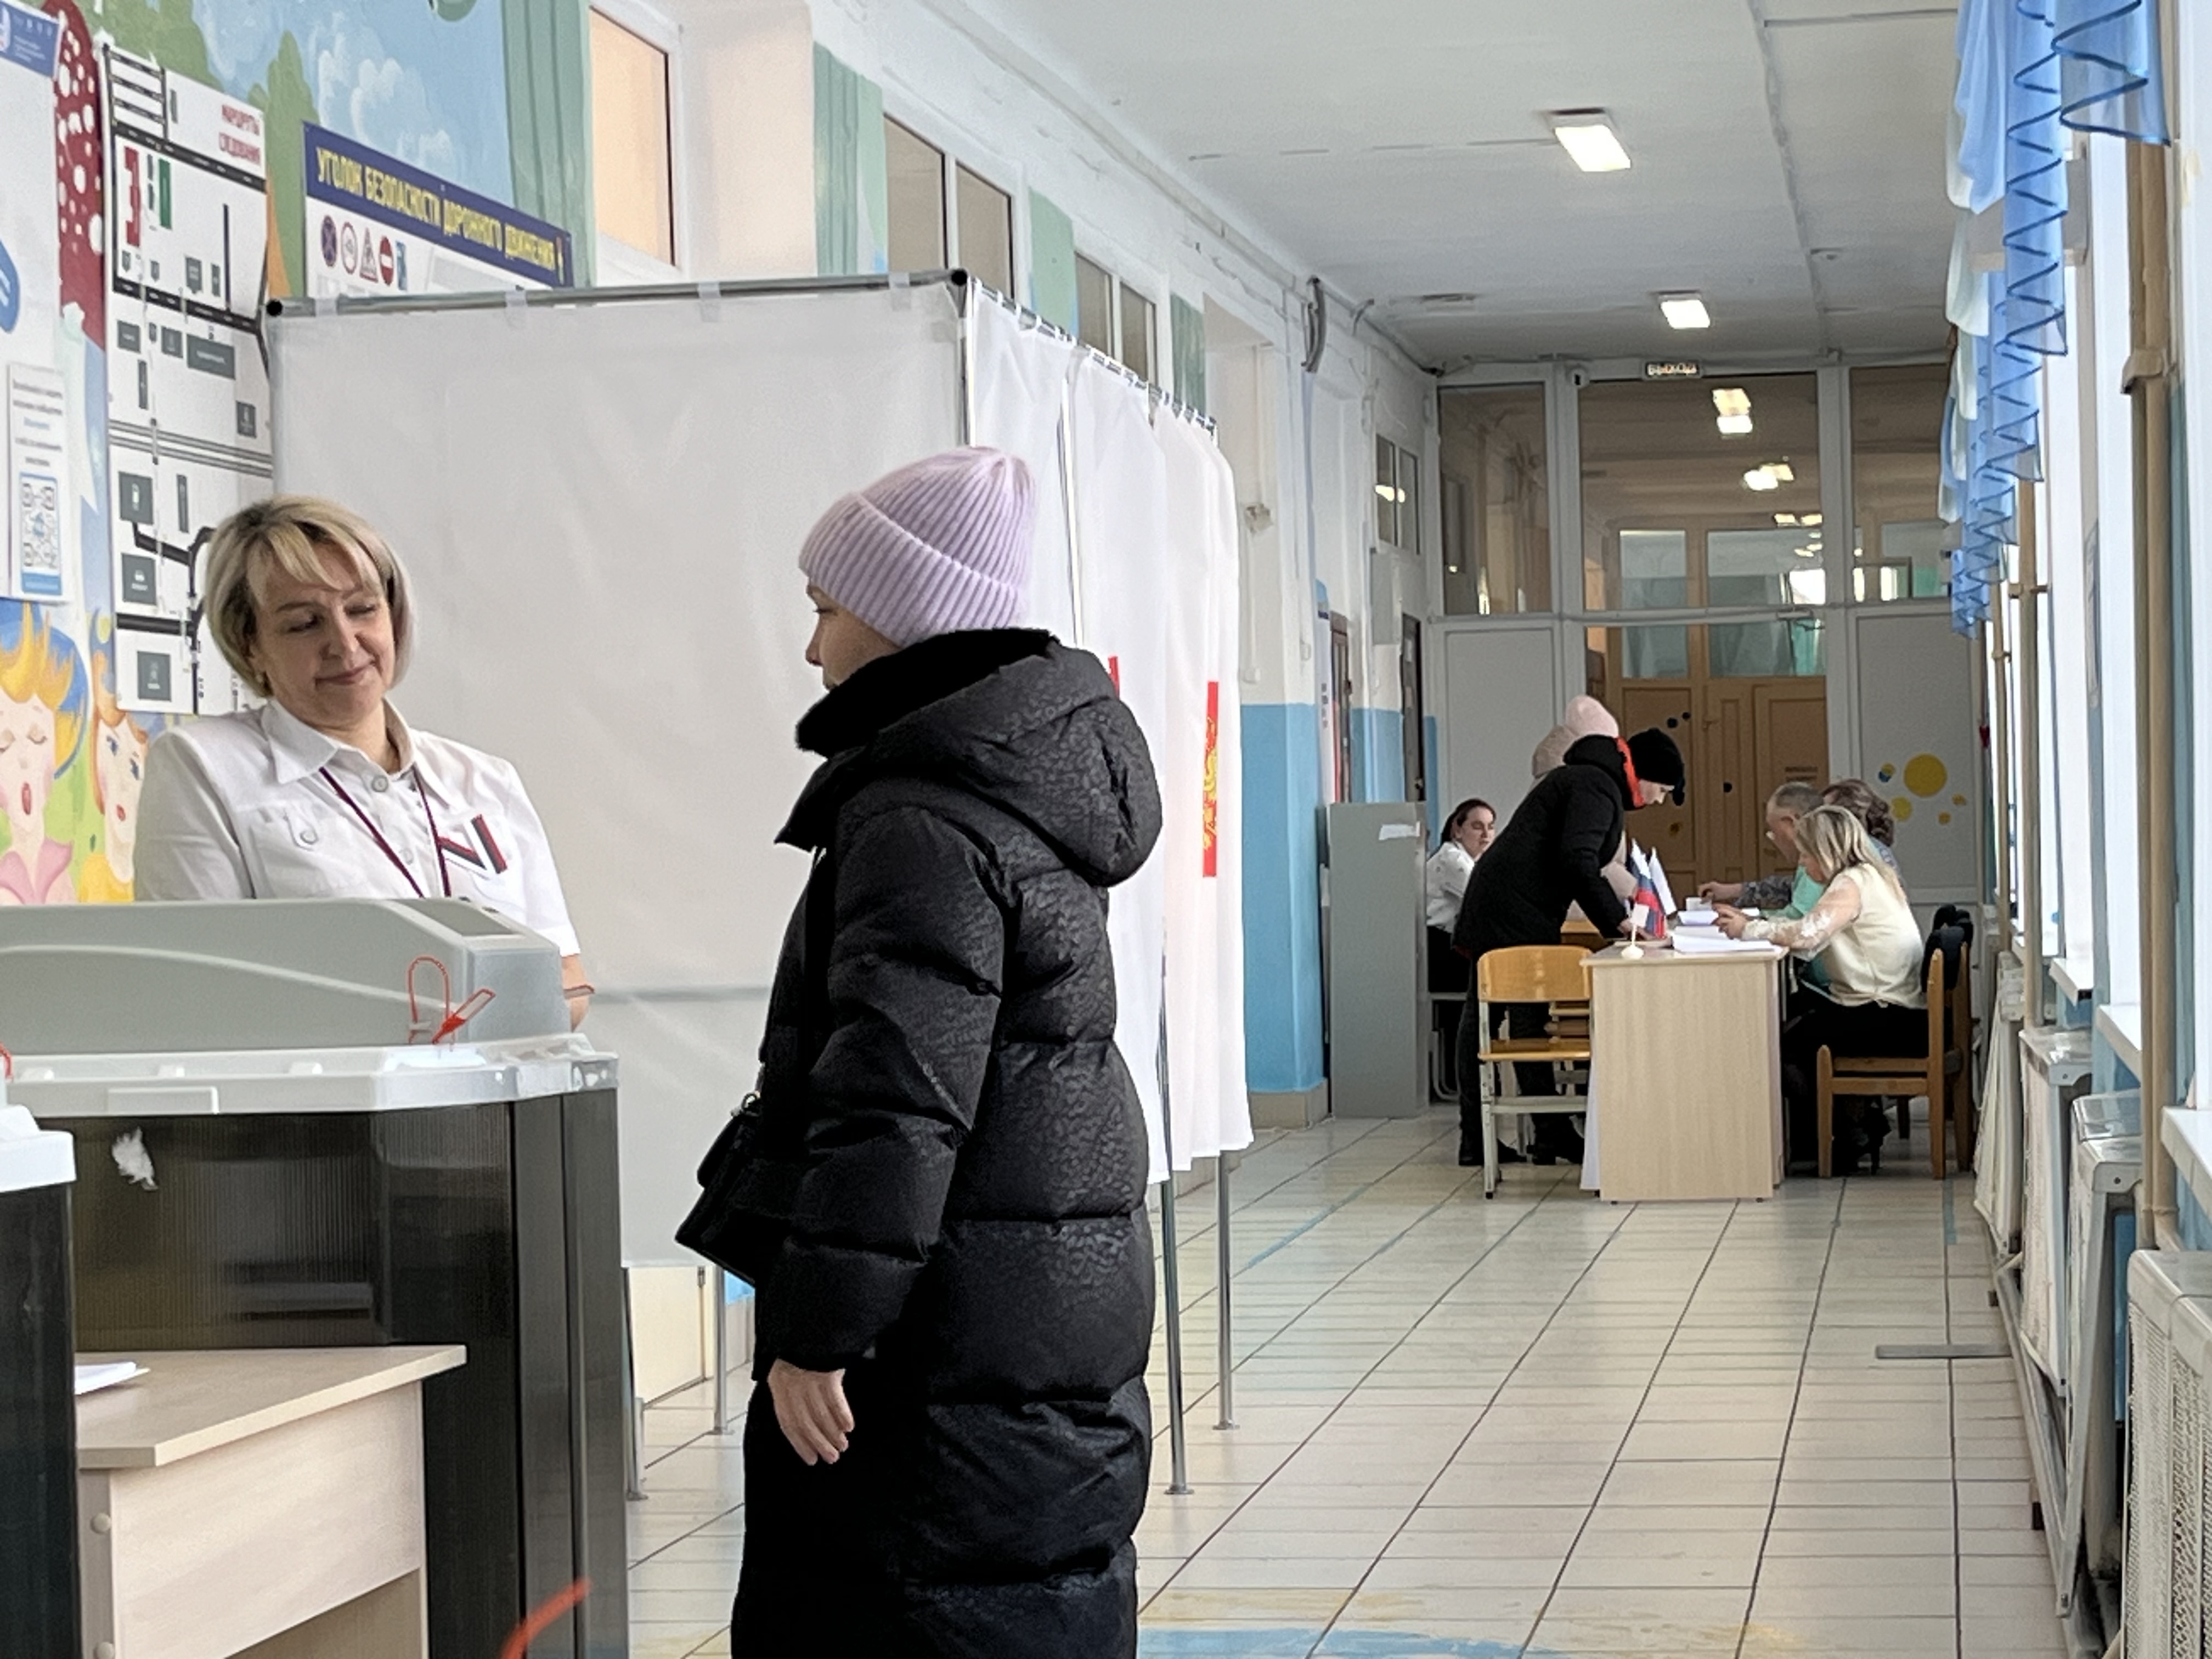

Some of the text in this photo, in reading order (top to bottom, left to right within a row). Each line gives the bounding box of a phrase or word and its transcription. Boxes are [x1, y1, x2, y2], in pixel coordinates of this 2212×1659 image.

[317, 147, 363, 196] УГОЛОК
[365, 166, 441, 225] БЕЗОПАСНОСТИ
[443, 199, 501, 251] ДОРОЖНОГО
